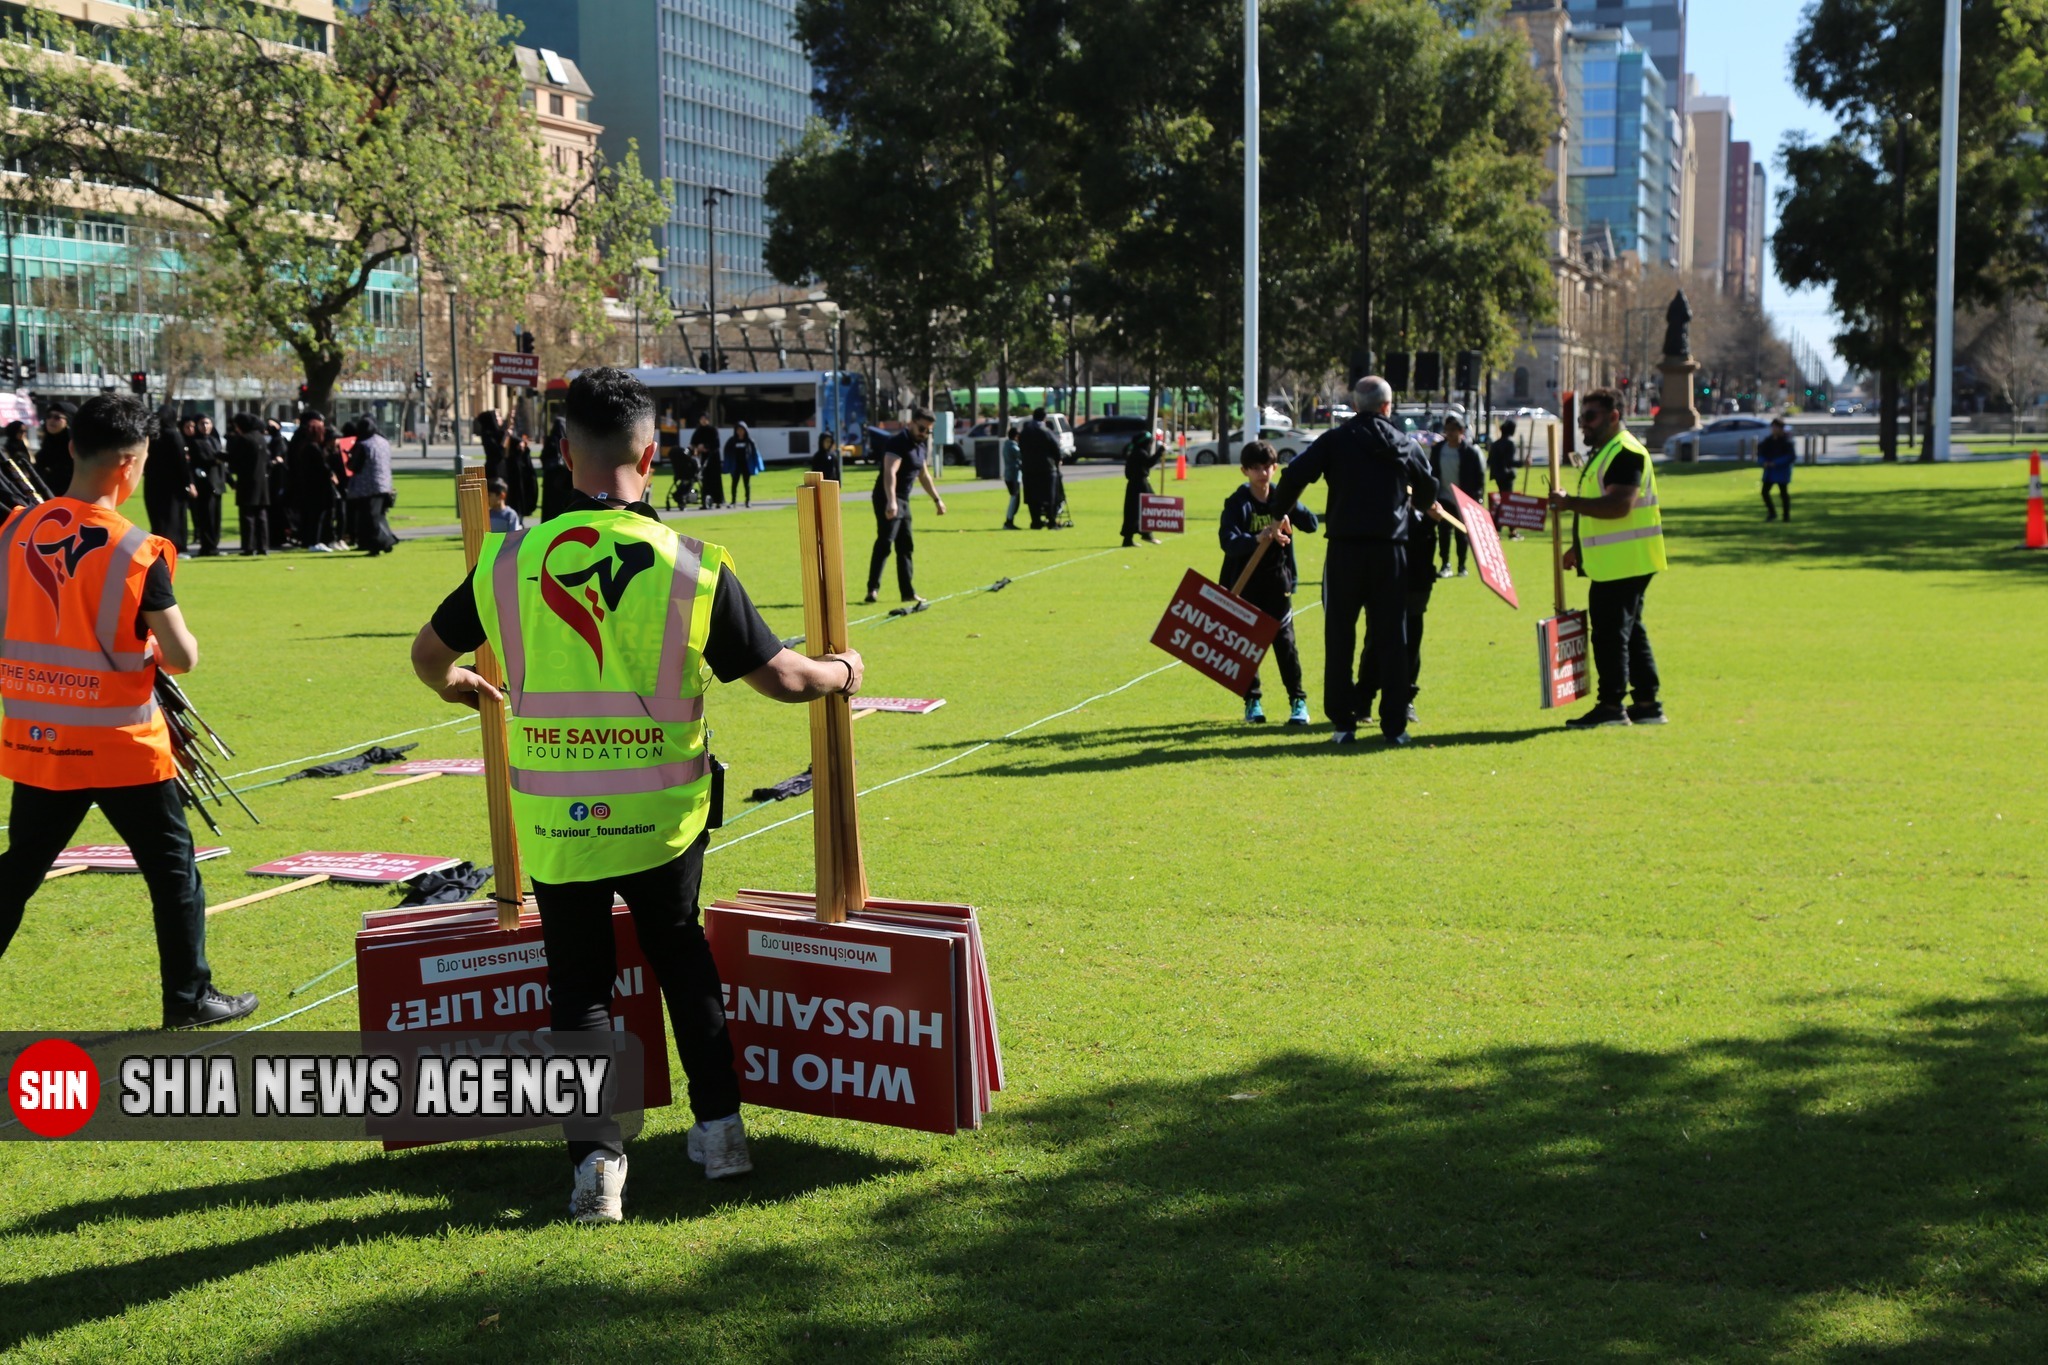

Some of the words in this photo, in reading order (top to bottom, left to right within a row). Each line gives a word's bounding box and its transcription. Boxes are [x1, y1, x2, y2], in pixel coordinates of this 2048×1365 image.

[499, 356, 523, 365] WHO
[525, 358, 533, 366] IS
[493, 365, 538, 376] HUSSAIN?
[1142, 507, 1184, 518] HUSSAIN?
[1147, 519, 1155, 528] IS
[1156, 519, 1179, 529] WHO
[1170, 599, 1265, 663] HUSSAIN?
[1170, 628, 1192, 650] IS
[1191, 641, 1241, 680] WHO
[1, 664, 25, 679] THE
[28, 668, 100, 688] SAVIOUR
[523, 727, 561, 744] THE
[567, 728, 665, 745] SAVIOUR
[527, 746, 663, 760] FOUNDATION
[534, 823, 656, 839] the_saviour_foundation
[302, 855, 420, 867] HUSSAIN
[359, 863, 417, 873] LIFE?
[761, 934, 878, 963] whoishussain.org
[386, 990, 483, 1032] LIFE?
[744, 1045, 779, 1084] IS
[792, 1053, 916, 1105] WHO
